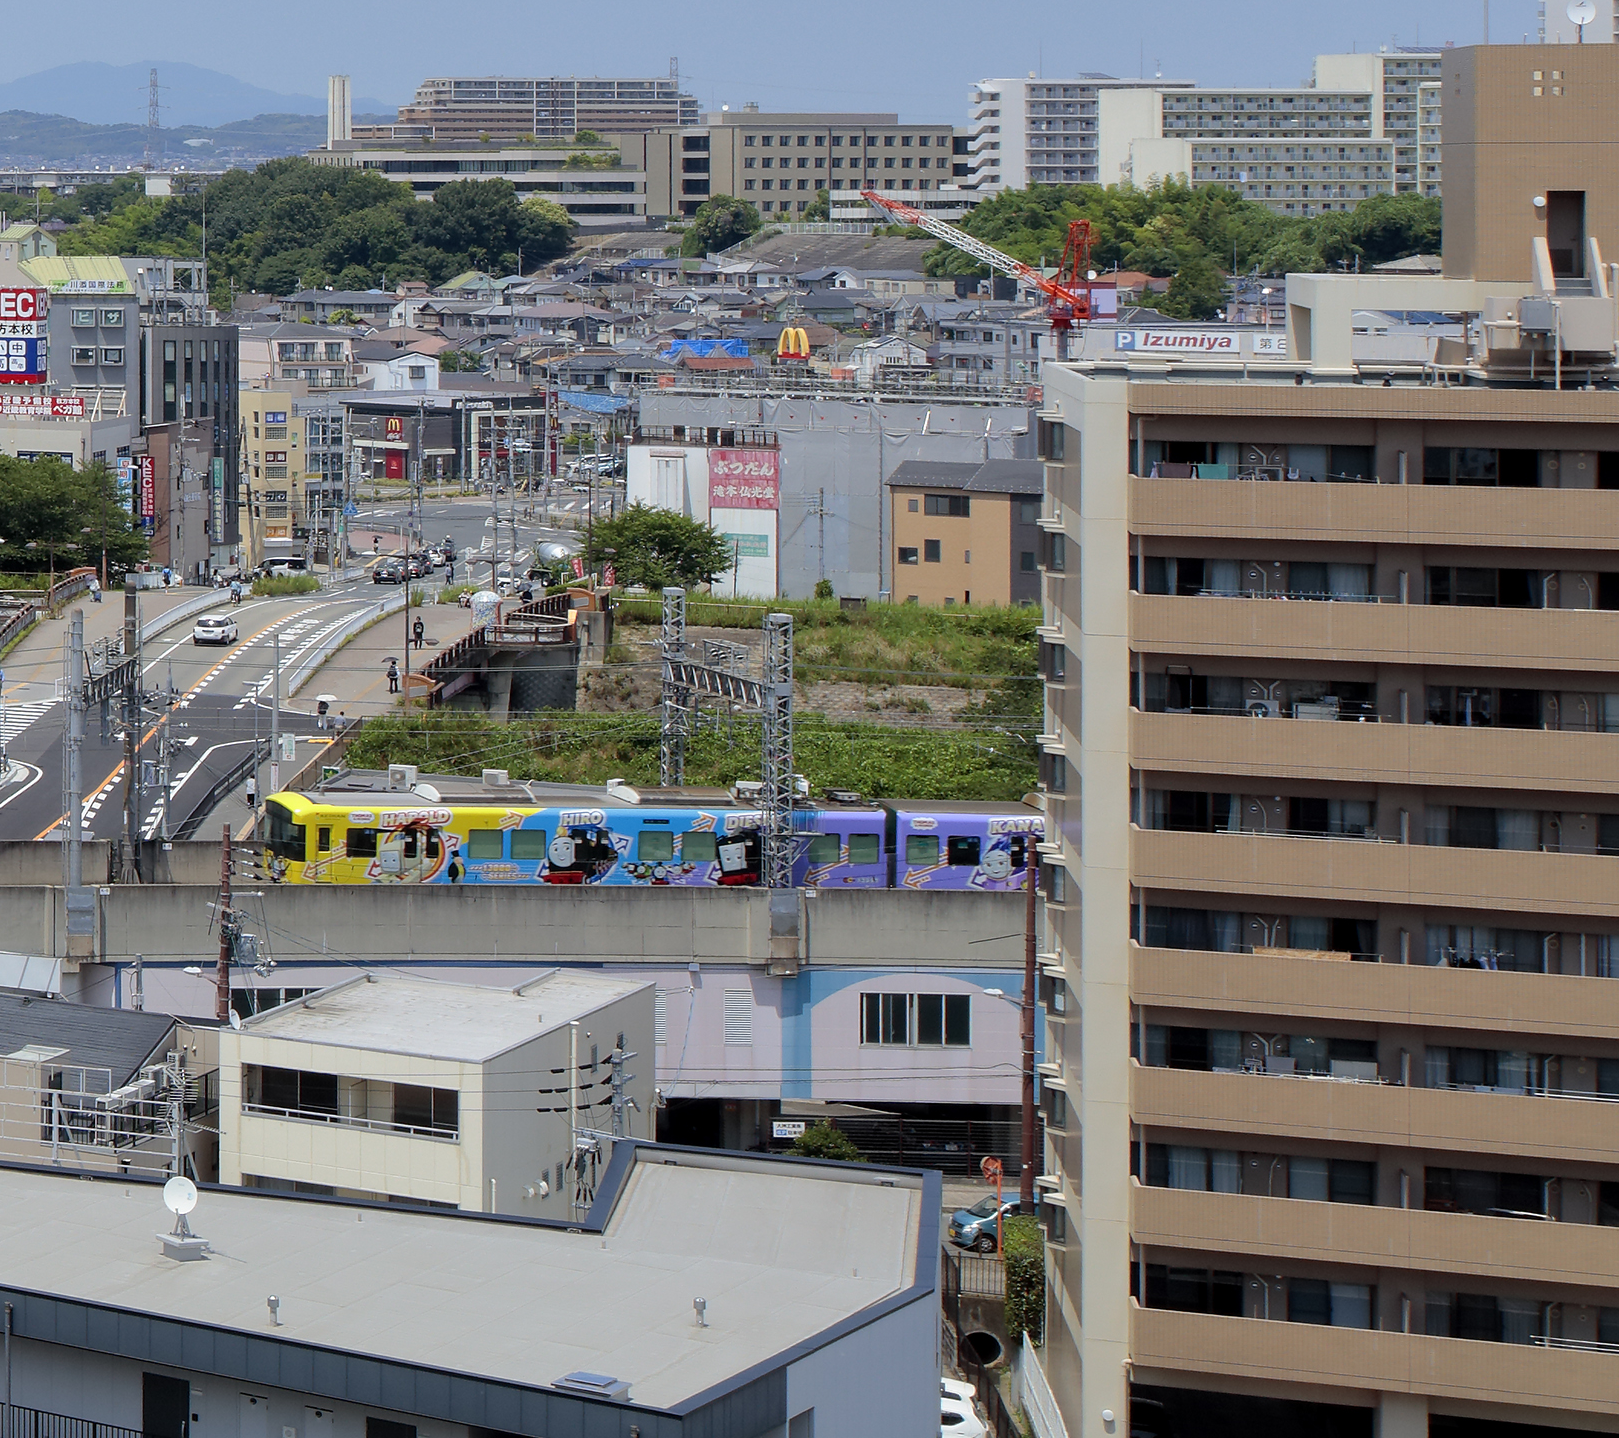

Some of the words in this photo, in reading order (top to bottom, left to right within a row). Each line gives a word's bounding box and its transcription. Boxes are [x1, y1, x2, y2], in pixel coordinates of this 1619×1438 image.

[12, 342, 23, 353] 中
[1117, 333, 1132, 348] P
[1143, 333, 1232, 350] Izumiya
[3, 396, 52, 405] 近畿予備校
[53, 405, 82, 415] ベガ館
[143, 458, 153, 487] KEC
[714, 461, 775, 476] ぶつだん
[713, 485, 775, 499] 滝本仏光堂
[561, 811, 604, 826] HIRO
[991, 819, 1043, 835] KANA
